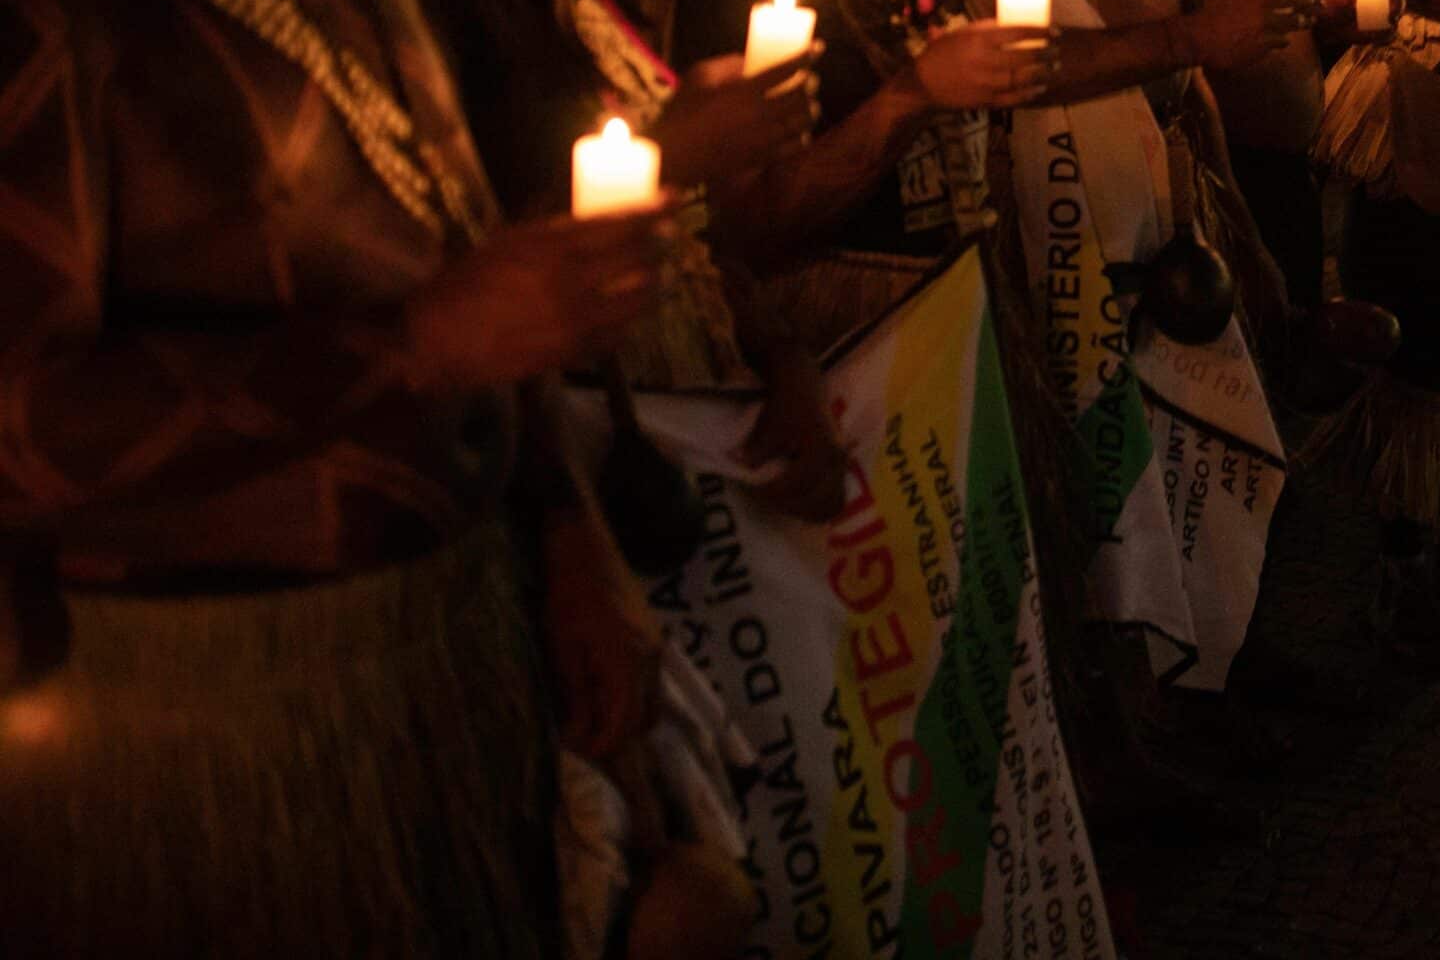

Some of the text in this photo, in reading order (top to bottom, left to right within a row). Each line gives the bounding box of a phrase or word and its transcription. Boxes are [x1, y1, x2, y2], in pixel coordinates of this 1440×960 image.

[1047, 130, 1078, 183] DA
[880, 412, 957, 618] ESTRANHAS
[1177, 459, 1212, 561] ARTIGO
[725, 613, 783, 705] DO
